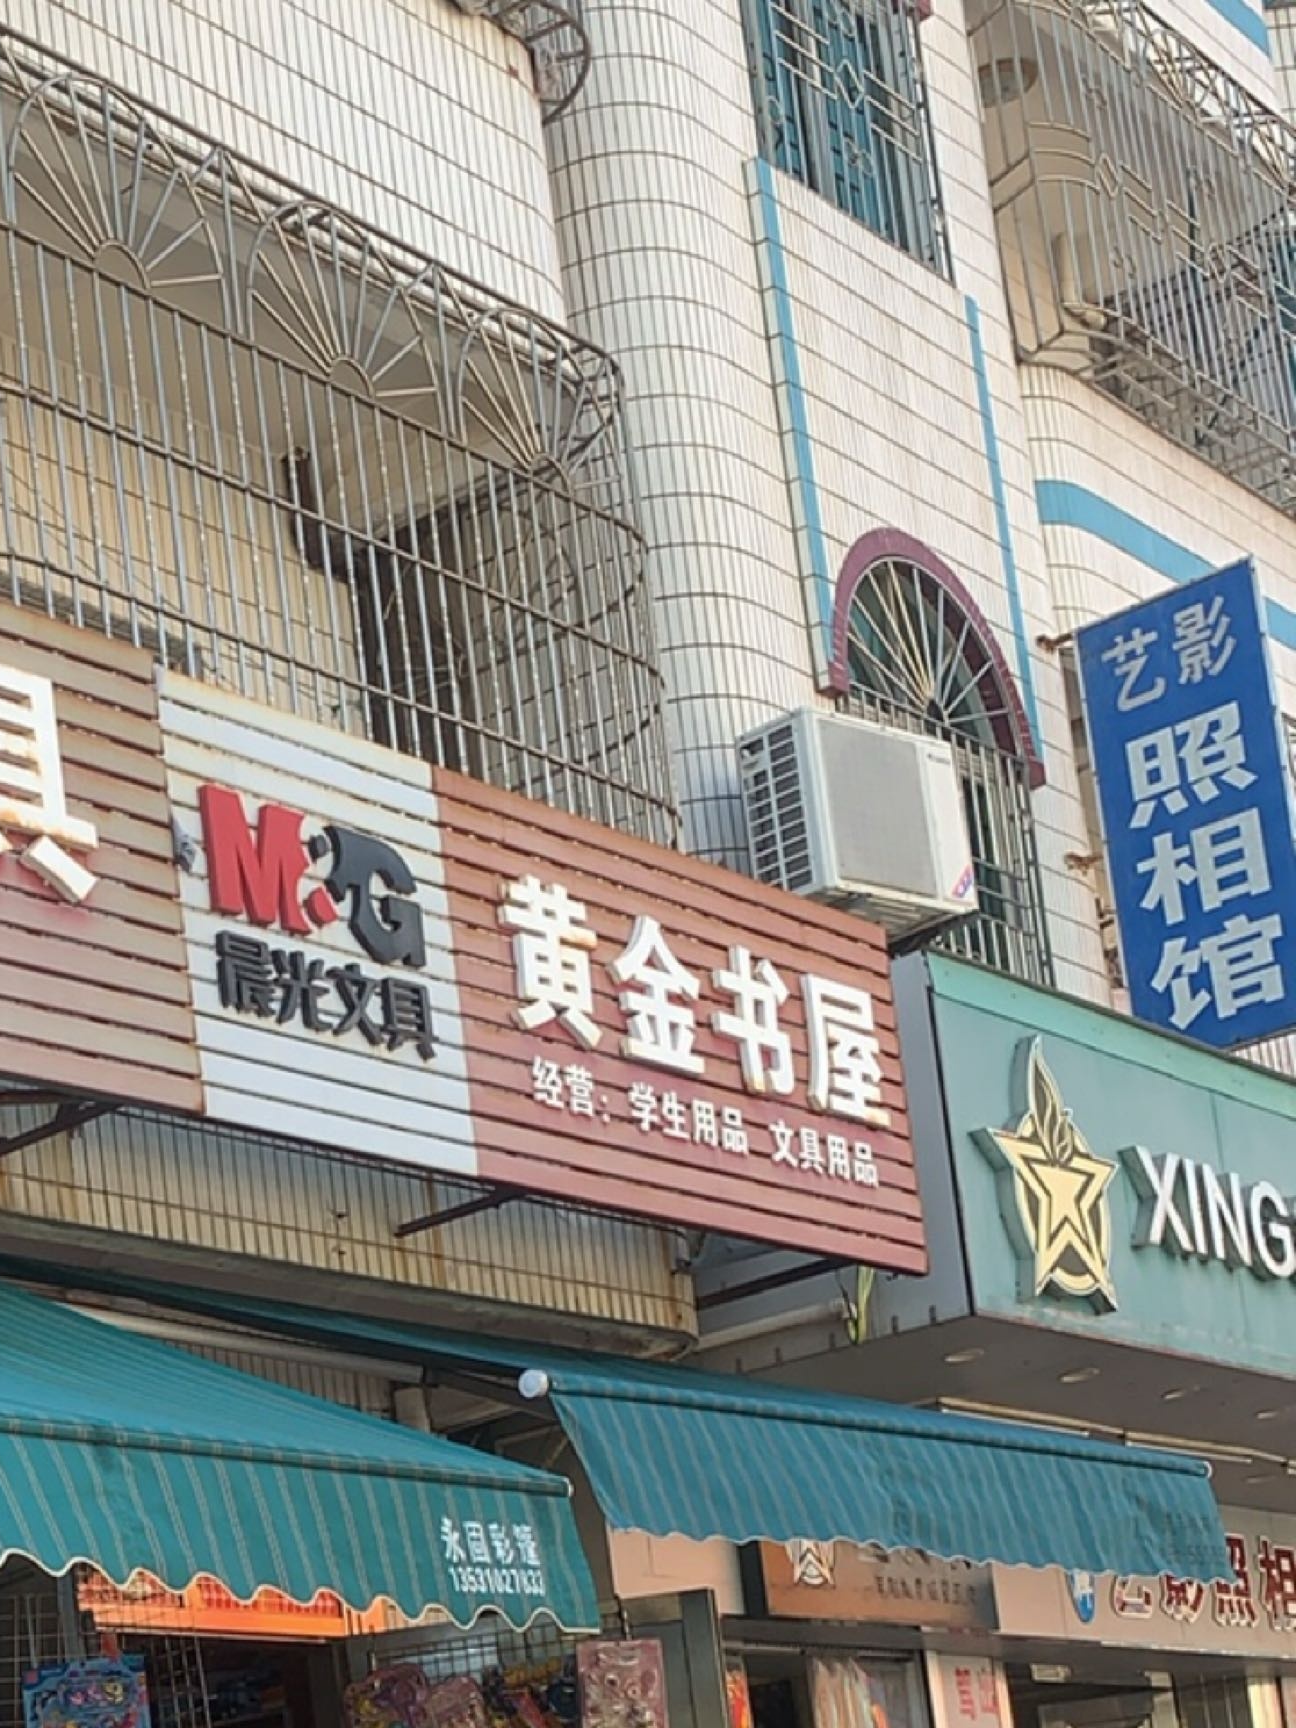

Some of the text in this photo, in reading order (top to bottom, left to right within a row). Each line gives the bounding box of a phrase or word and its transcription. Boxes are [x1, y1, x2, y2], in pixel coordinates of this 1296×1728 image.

[1102, 594, 1234, 714] 艺影
[1124, 701, 1287, 1031] 照相馆
[215, 929, 439, 1062] 晨光文具
[500, 873, 891, 1128] 黄金书屋
[768, 1118, 880, 1188] 文具用品
[1117, 1144, 1296, 1279] XING
